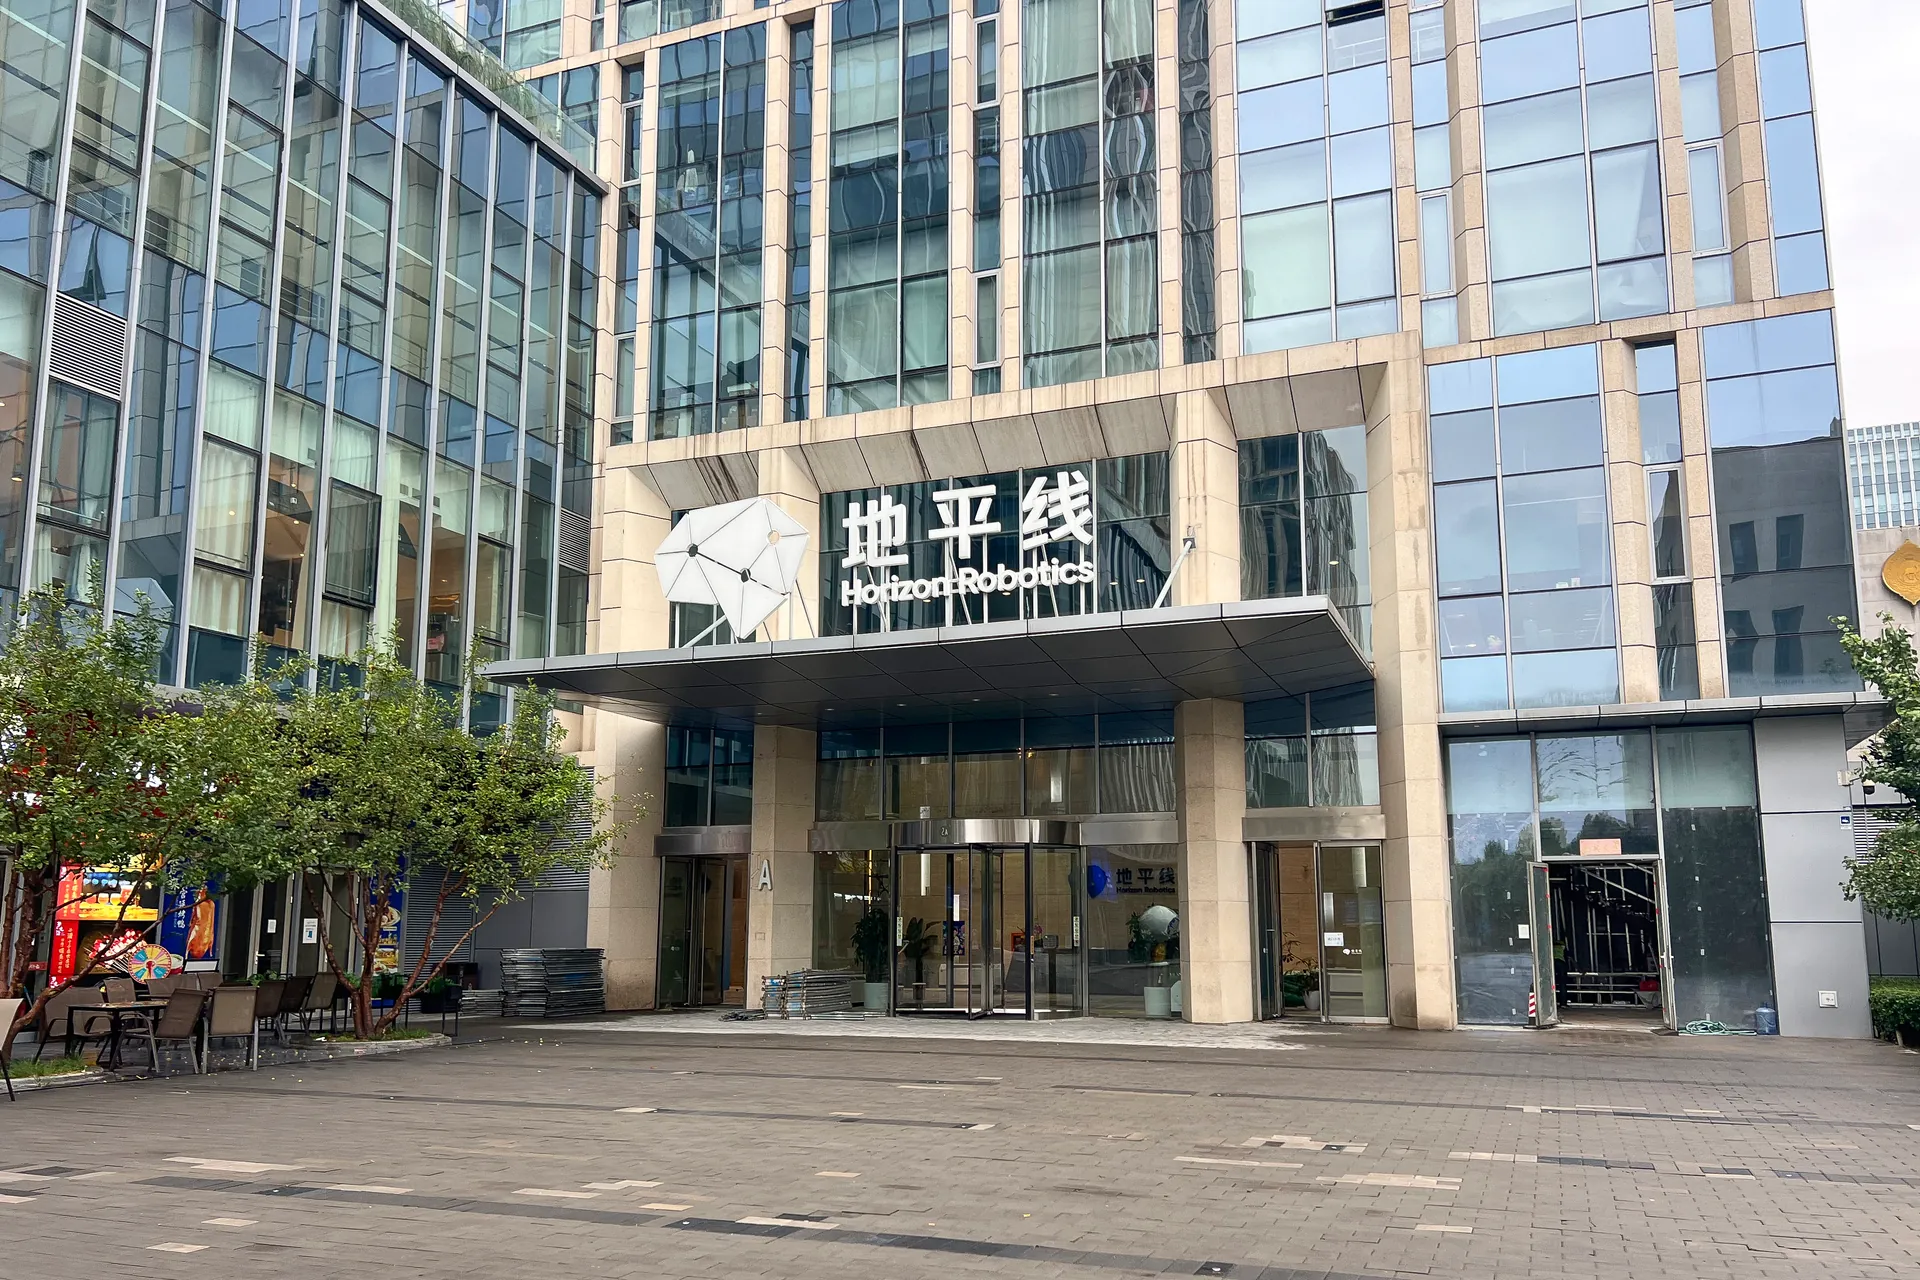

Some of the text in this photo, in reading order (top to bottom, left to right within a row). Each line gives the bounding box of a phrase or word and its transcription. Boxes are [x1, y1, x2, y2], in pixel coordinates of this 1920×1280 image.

[841, 469, 1094, 569] 地平线
[841, 557, 1095, 607] Horizon Robotics
[759, 859, 773, 891] A
[1116, 867, 1175, 885] 地平线
